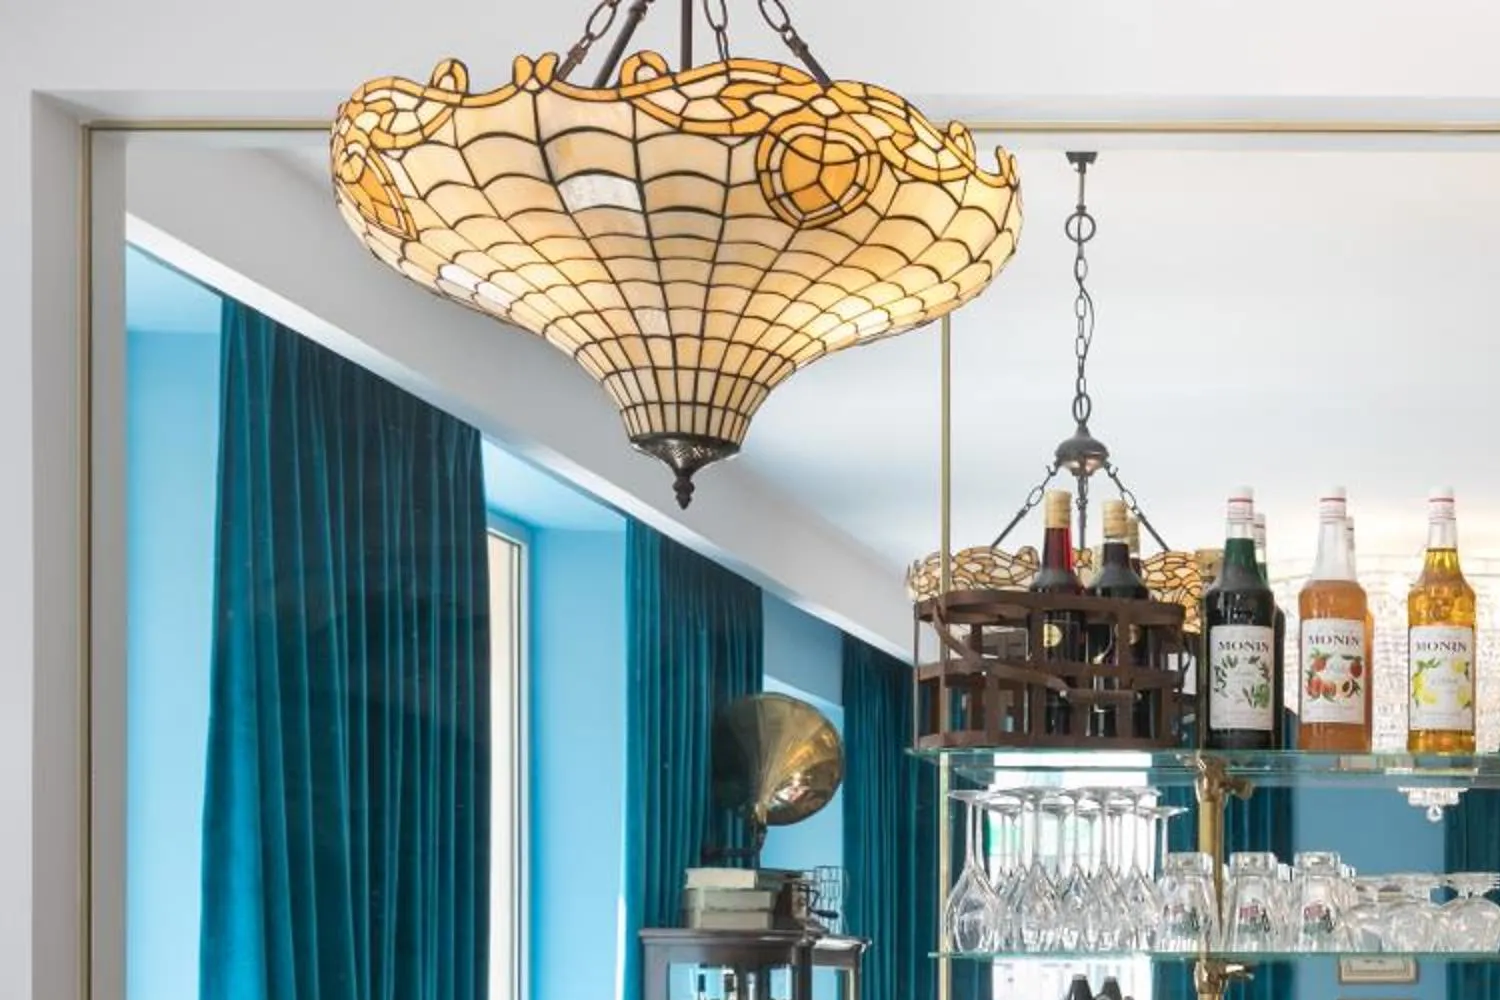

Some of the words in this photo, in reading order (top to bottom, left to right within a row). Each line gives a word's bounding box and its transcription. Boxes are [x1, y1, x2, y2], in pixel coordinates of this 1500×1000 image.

[1218, 640, 1270, 652] MONIN
[1308, 634, 1360, 646] MONIN
[1416, 640, 1467, 652] MONIN
